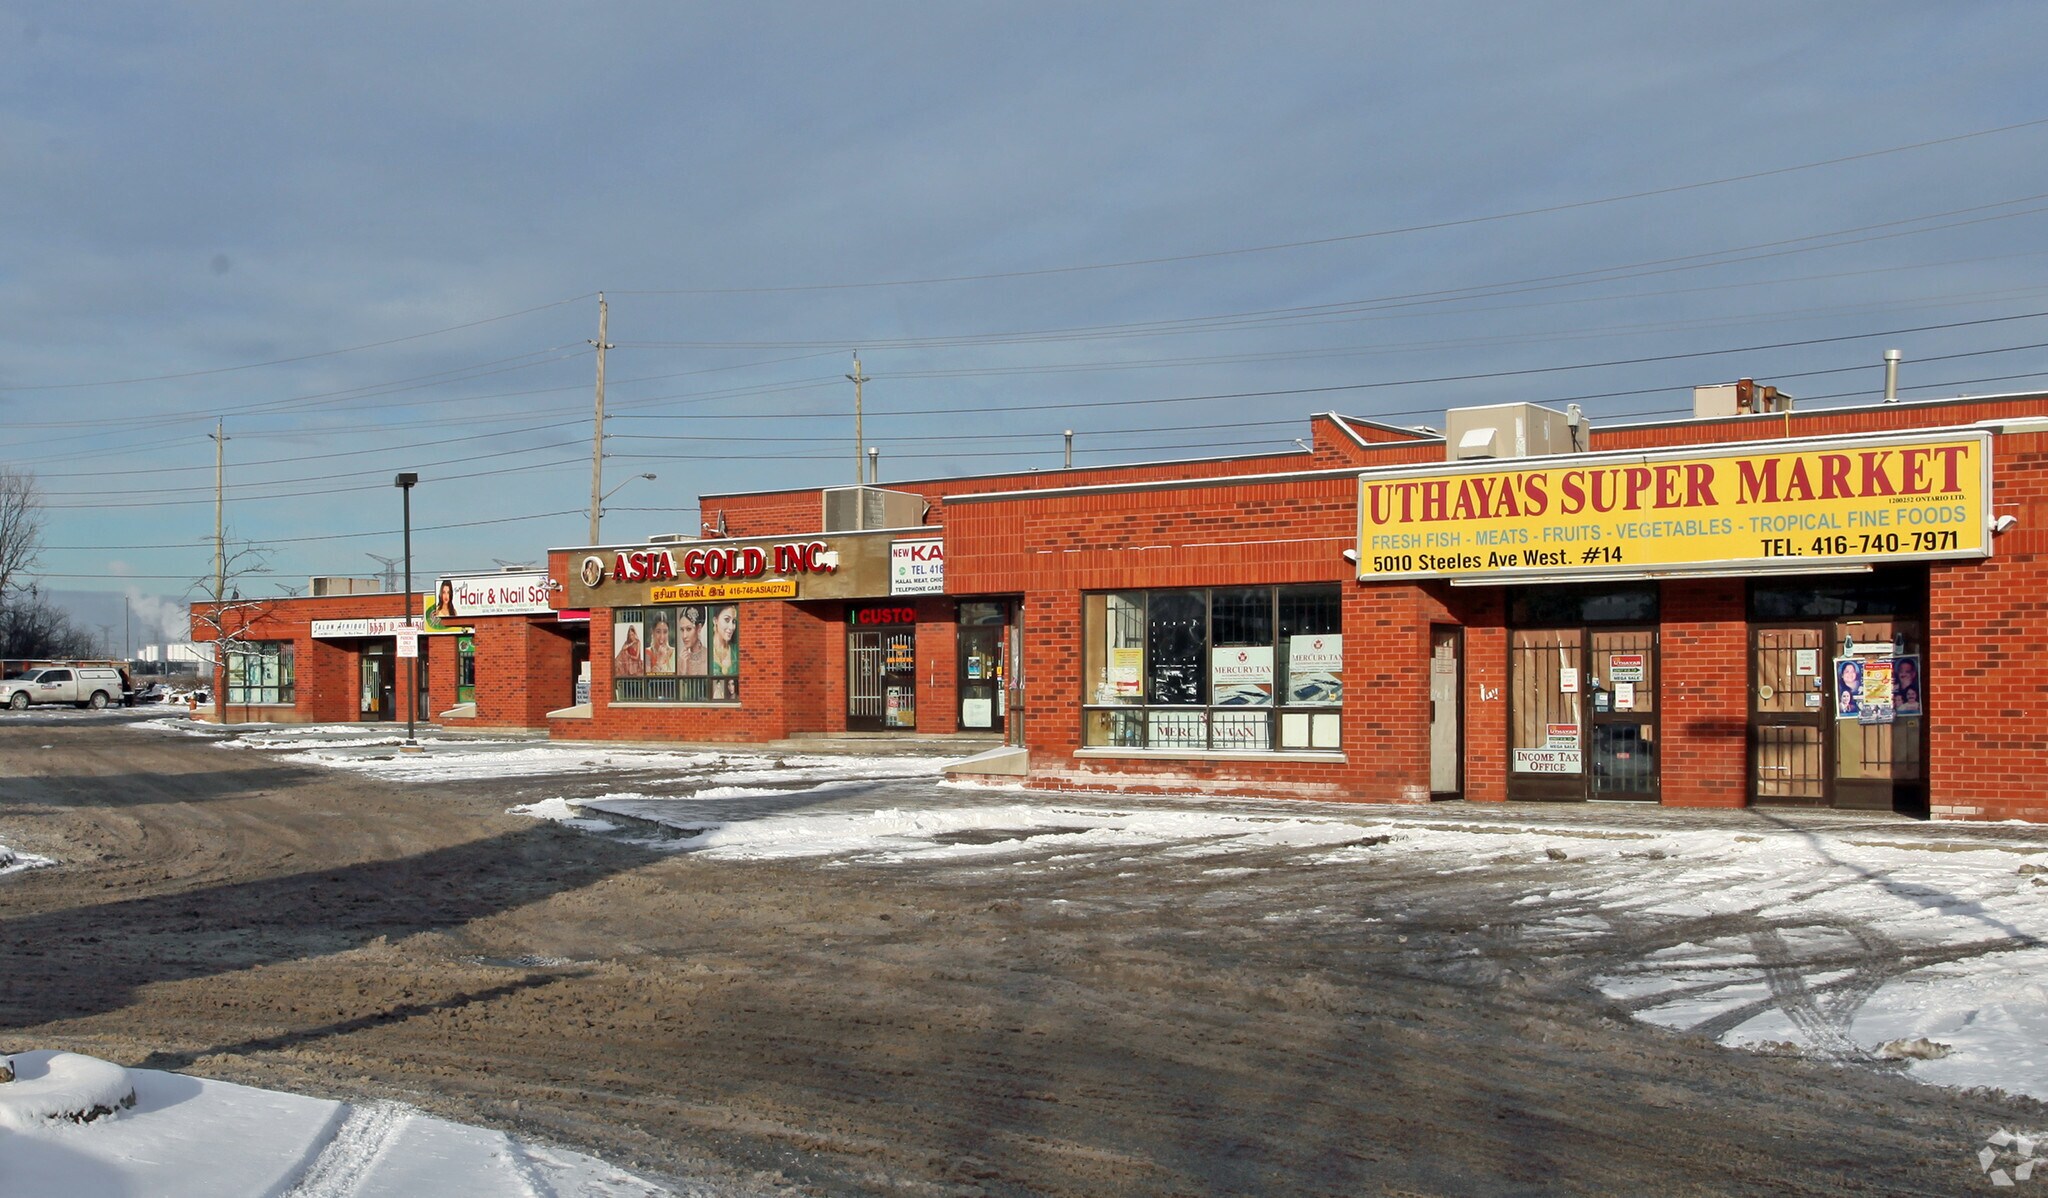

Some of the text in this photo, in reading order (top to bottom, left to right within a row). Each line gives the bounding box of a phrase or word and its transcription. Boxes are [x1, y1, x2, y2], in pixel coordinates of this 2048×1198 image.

[1368, 446, 1969, 525] UTHAYA'S SUPER MARKET
[1915, 495, 1948, 503] ONTARIO
[1950, 494, 1967, 502] LTD.
[1372, 533, 1421, 551] FRESH
[1427, 531, 1460, 548] FISH
[1476, 528, 1528, 546] MEATS
[1543, 524, 1601, 542] FRUITS
[1616, 517, 1732, 539] VEGETABLES
[1749, 512, 1841, 533] TROPICAL
[1848, 508, 1890, 528] FINE
[1896, 505, 1966, 526] FOODS
[1761, 530, 1958, 557] TEL: 416-740-7971
[893, 548, 909, 558] NEW
[612, 552, 674, 580] ASIA
[684, 548, 764, 579] GOLD
[1374, 546, 1623, 572] 5010 Steeles Ave West. #14
[911, 565, 927, 575] TEL.
[460, 587, 484, 606] Hair
[487, 588, 496, 605] &
[500, 586, 524, 604] Nail
[859, 607, 916, 624] CUSTO
[1292, 653, 1343, 662] MERCURY TAX
[1214, 665, 1272, 674] MERCURY TAX
[1158, 726, 1254, 737] MERCUY TAX
[1517, 751, 1578, 762] INCOME TAX
[1530, 761, 1566, 771] OFFICE
